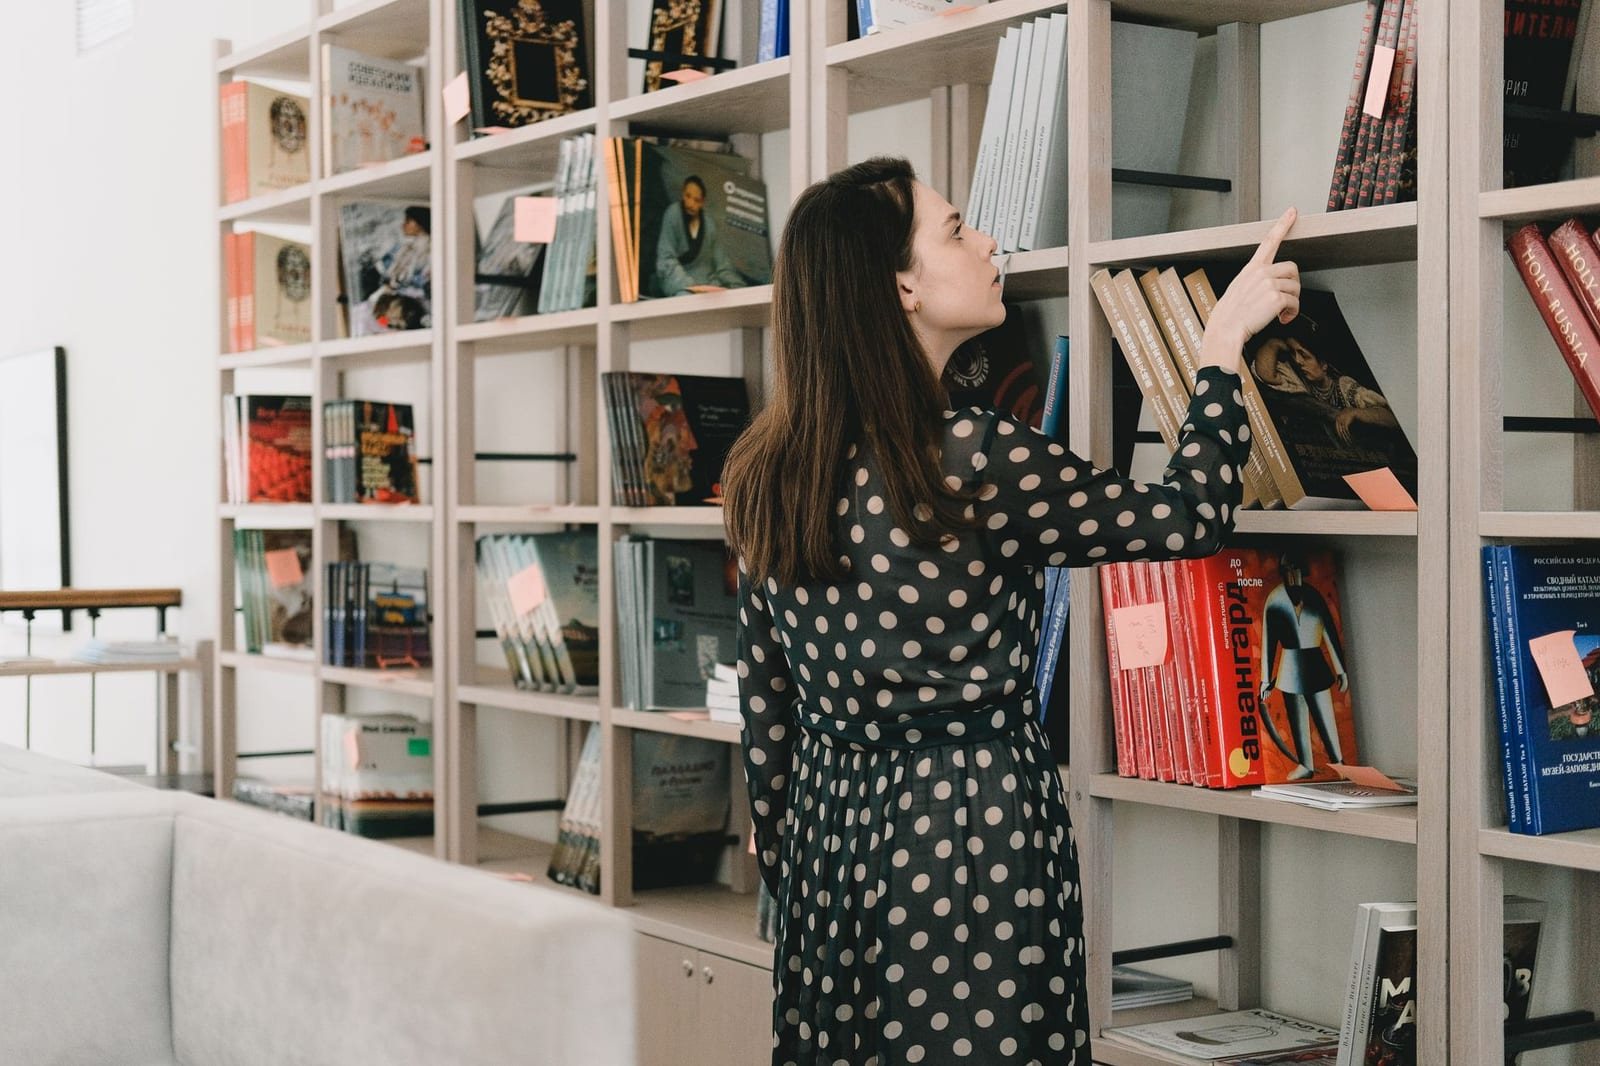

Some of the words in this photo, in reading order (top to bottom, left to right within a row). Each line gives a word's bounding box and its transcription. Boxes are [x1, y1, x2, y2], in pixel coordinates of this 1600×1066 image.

[1502, 80, 1528, 97] РИЯ
[1565, 243, 1599, 292] HOLY
[1522, 248, 1553, 295] HOLY
[1548, 299, 1589, 369] RUSSIA
[1229, 558, 1242, 569] до
[1236, 568, 1243, 577] и
[1237, 577, 1263, 588] после
[1546, 574, 1576, 585] СВОДНЫЙ
[1044, 647, 1055, 672] World
[1050, 630, 1058, 648] Fine
[1226, 582, 1260, 762] авангард
[1525, 792, 1533, 825] СВОДНЫЙ
